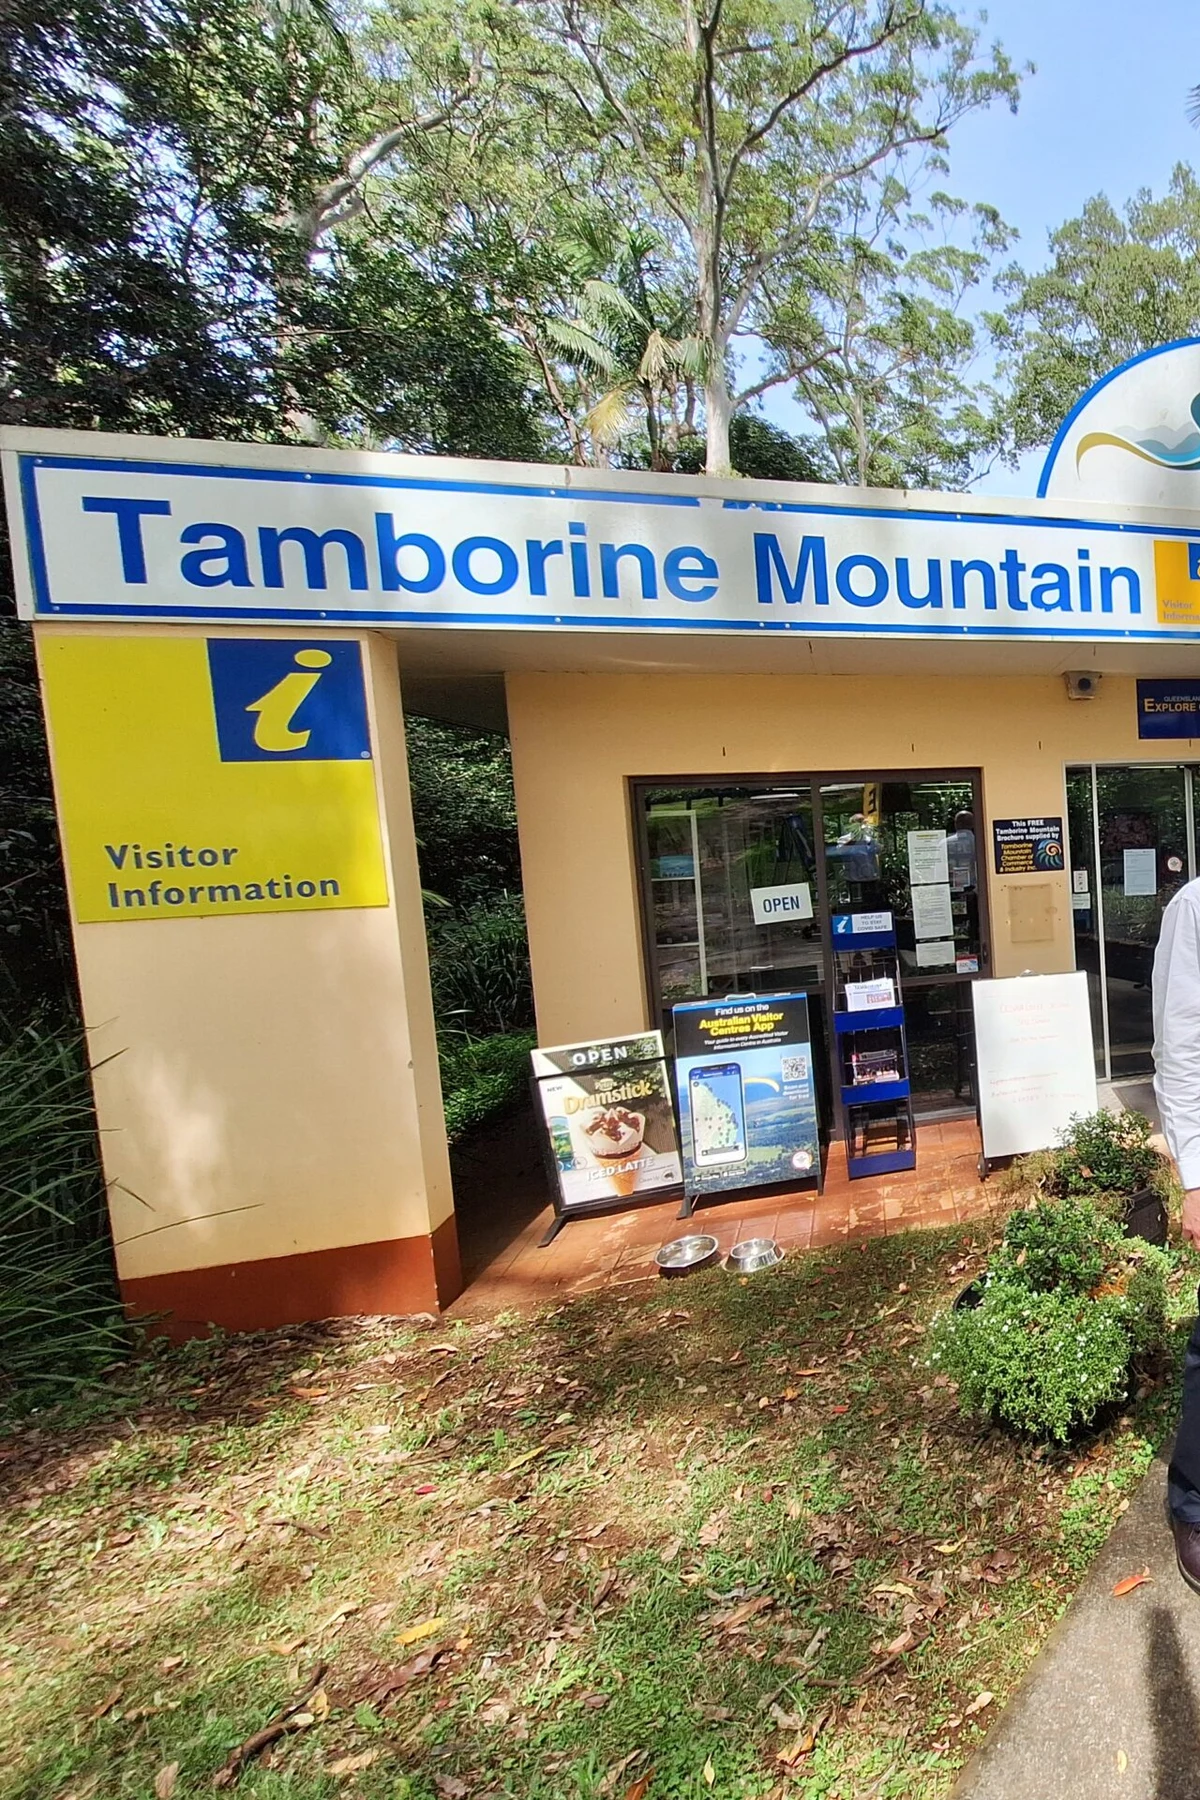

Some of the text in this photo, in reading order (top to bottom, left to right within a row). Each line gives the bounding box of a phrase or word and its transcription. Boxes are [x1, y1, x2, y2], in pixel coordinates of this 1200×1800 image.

[82, 496, 719, 604] Tamborine
[753, 532, 1142, 614] Mountain
[1162, 599, 1193, 609] Visitor
[1144, 698, 1197, 712] EXPLORE
[997, 832, 1060, 842] Brochure supplied by
[105, 842, 239, 872] Visitor
[107, 873, 341, 910] Information
[763, 895, 800, 914] OPEN
[715, 1003, 769, 1016] Find us on the
[699, 1012, 784, 1029] Australian Visitor
[710, 1021, 775, 1036] Centres App
[572, 1045, 628, 1066] OPEN
[587, 1166, 615, 1181] ICED
[616, 1157, 655, 1174] LATTE
